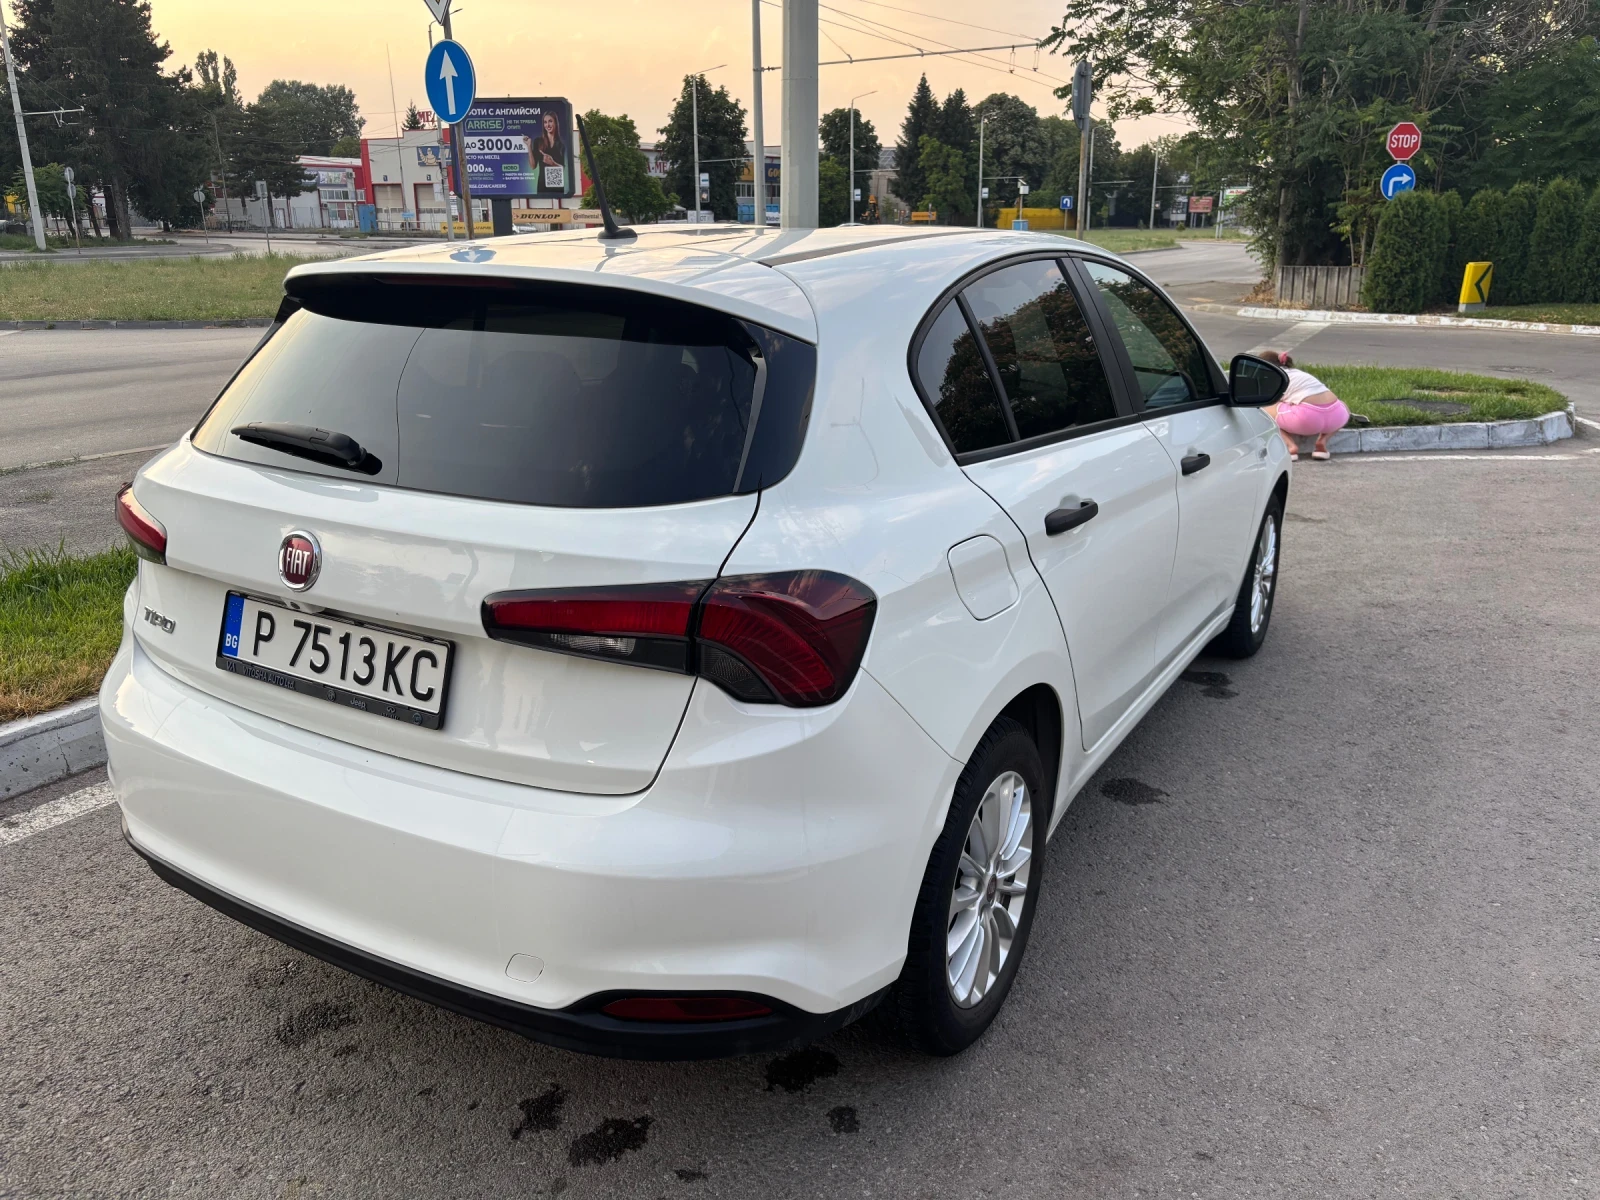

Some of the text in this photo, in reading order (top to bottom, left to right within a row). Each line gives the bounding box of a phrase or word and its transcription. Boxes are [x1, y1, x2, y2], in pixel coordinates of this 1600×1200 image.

[495, 106, 541, 116] АНГЛИЙСКИ
[467, 120, 502, 130] ARRISE
[478, 138, 512, 150] 3000
[1390, 134, 1418, 148] STOP
[286, 547, 310, 575] FIAT
[144, 605, 176, 634] TIPO
[252, 610, 275, 656] P
[225, 633, 238, 648] BG
[242, 666, 267, 680] VITOSHA
[268, 674, 284, 686] AUTO
[350, 698, 366, 710] Jeep
